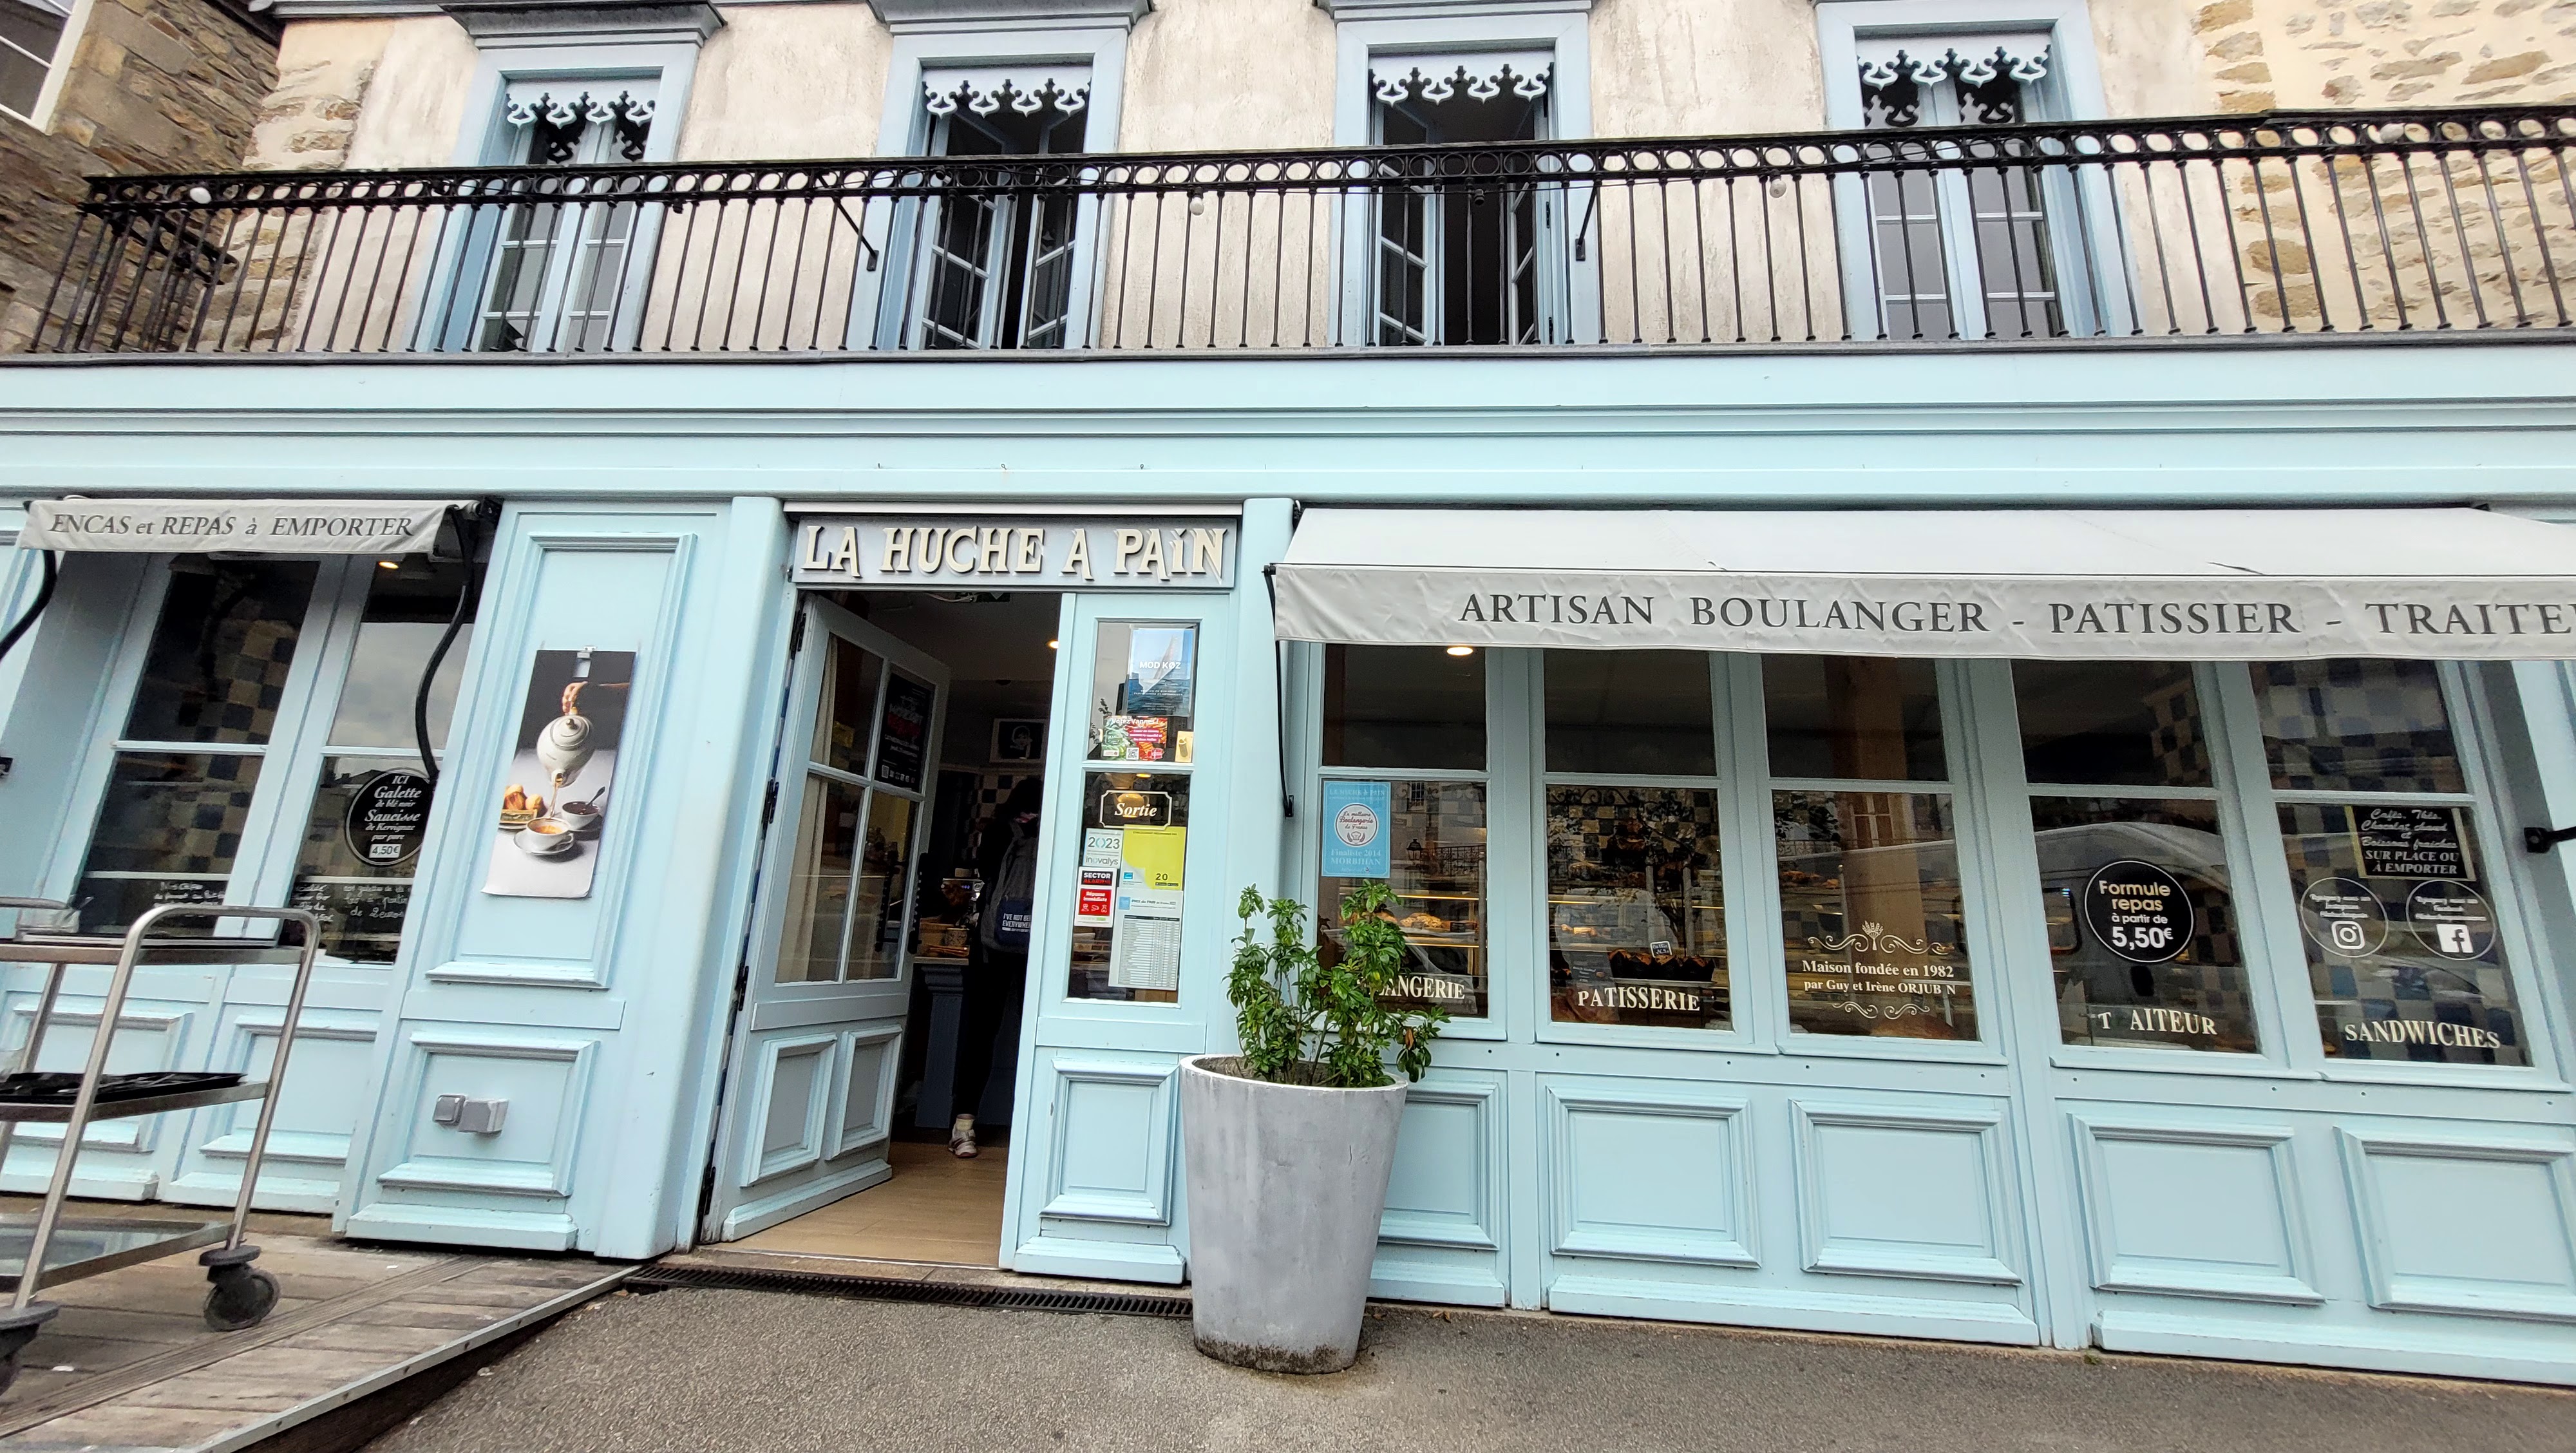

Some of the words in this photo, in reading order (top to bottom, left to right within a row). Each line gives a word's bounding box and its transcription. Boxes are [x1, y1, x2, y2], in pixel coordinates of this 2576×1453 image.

[48, 514, 131, 534] ENCAS
[135, 521, 156, 535] et
[161, 516, 236, 535] REPAS
[245, 517, 257, 535] à
[269, 517, 414, 537] EMPORTER
[801, 525, 862, 578] LA
[879, 526, 1045, 574] HUCHE
[1059, 528, 1094, 581] A
[1458, 593, 1654, 625] ARTISAN
[1689, 596, 1991, 632] BOULANGER
[2047, 602, 2303, 634] PATISSIER
[2365, 603, 2576, 635] TRAITE
[1139, 661, 1160, 669] MOD
[391, 775, 410, 784] ICI
[374, 785, 422, 799] Galette
[364, 809, 421, 822] Saucisse
[1114, 802, 1157, 817] Sortie
[2365, 850, 2391, 860] SUR
[2394, 851, 2437, 861] PLACE
[2439, 852, 2459, 862] OU
[2384, 862, 2458, 874] EMPORTER
[2098, 880, 2171, 897] Formule
[2111, 898, 2164, 913] repas
[2111, 913, 2120, 922] à
[2121, 914, 2150, 924] partir
[2152, 915, 2168, 924] de
[2111, 926, 2174, 951] 5,50€
[1801, 960, 1852, 973] Maison
[1855, 962, 1900, 975] fondée
[1902, 967, 1919, 976] en
[1923, 965, 1955, 978] 1982
[1804, 981, 1823, 991] par
[1826, 980, 1850, 992] Guy
[1852, 981, 1863, 991] et
[1865, 981, 1895, 992] Irène
[1577, 986, 1701, 1011] PATISSERIE
[2344, 1020, 2501, 1049] SANDWICHES
